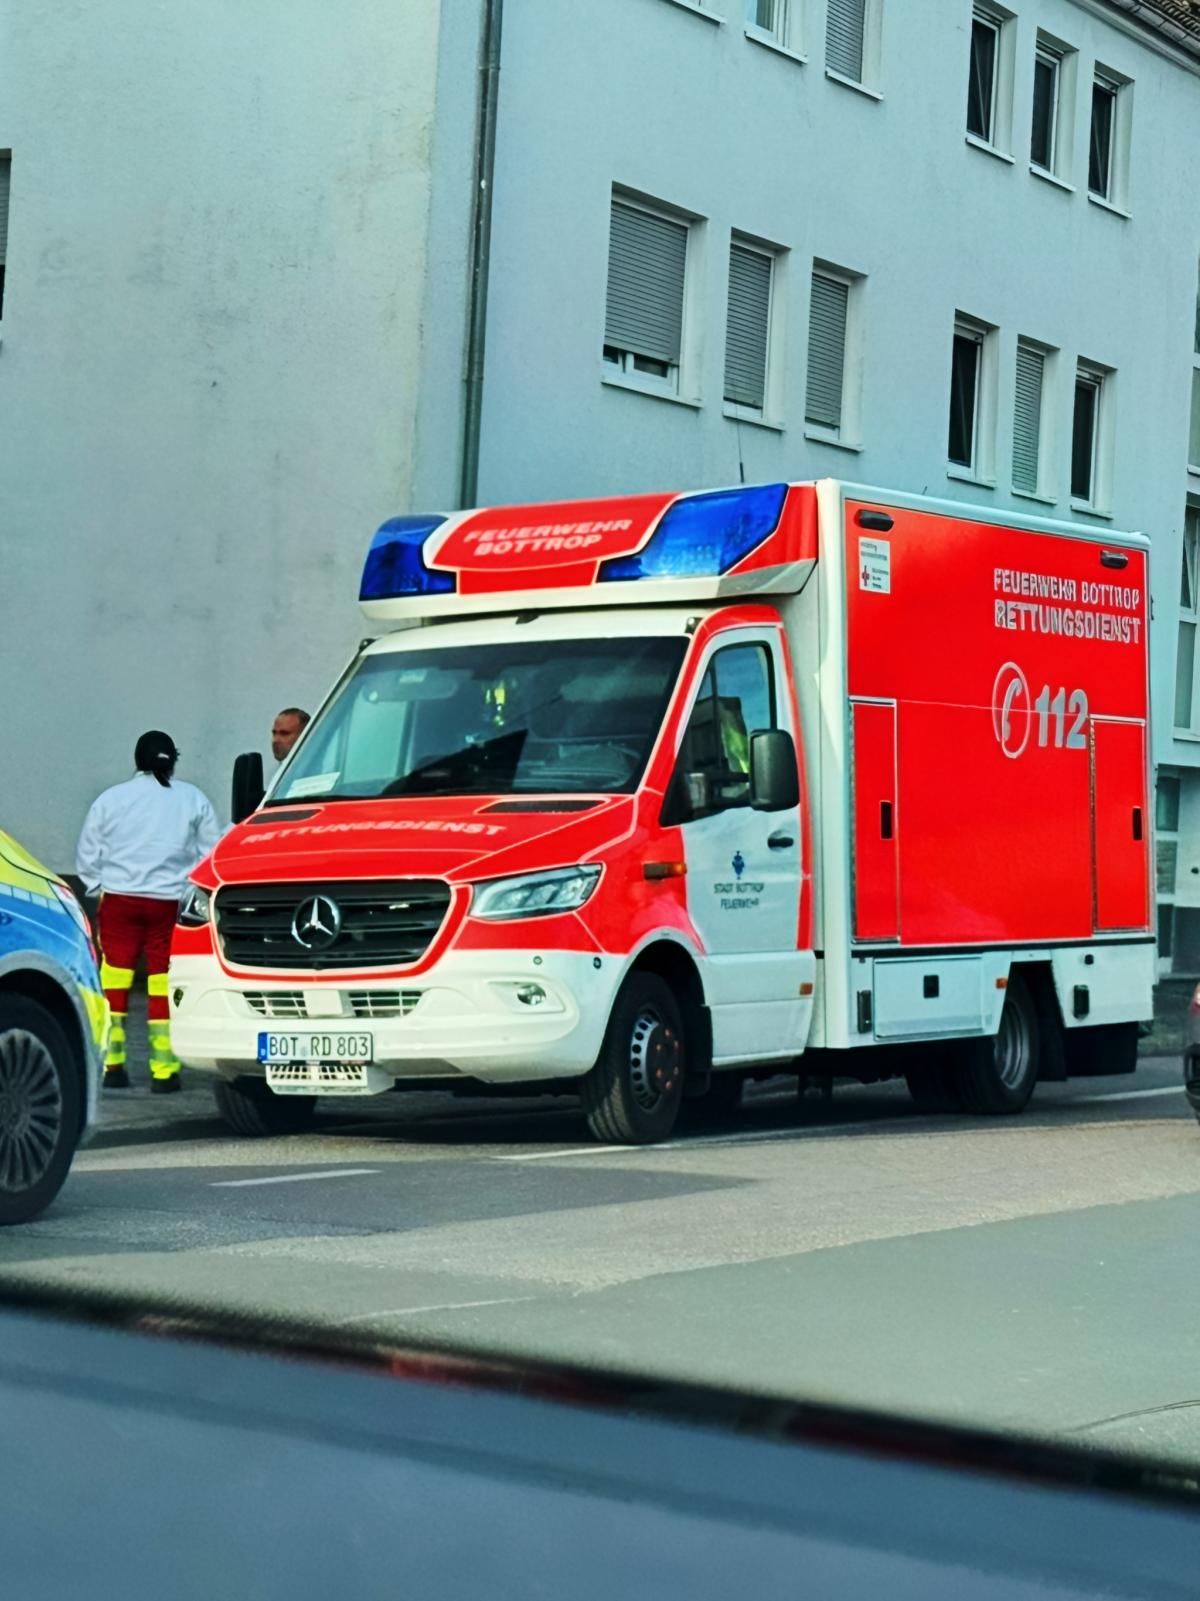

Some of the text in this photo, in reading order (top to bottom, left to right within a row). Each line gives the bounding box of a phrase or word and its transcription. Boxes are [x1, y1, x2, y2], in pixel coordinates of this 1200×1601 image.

[464, 519, 632, 543] FEUERWEHR
[474, 534, 602, 557] BOTTROP
[994, 568, 1140, 611] FEUERWEHR BOTTROP
[994, 599, 1141, 644] RETTUNGSDIENST
[1035, 684, 1088, 749] 112
[240, 820, 506, 845] RETTUNGSDIENST
[269, 1036, 368, 1056] BOT RD 803
